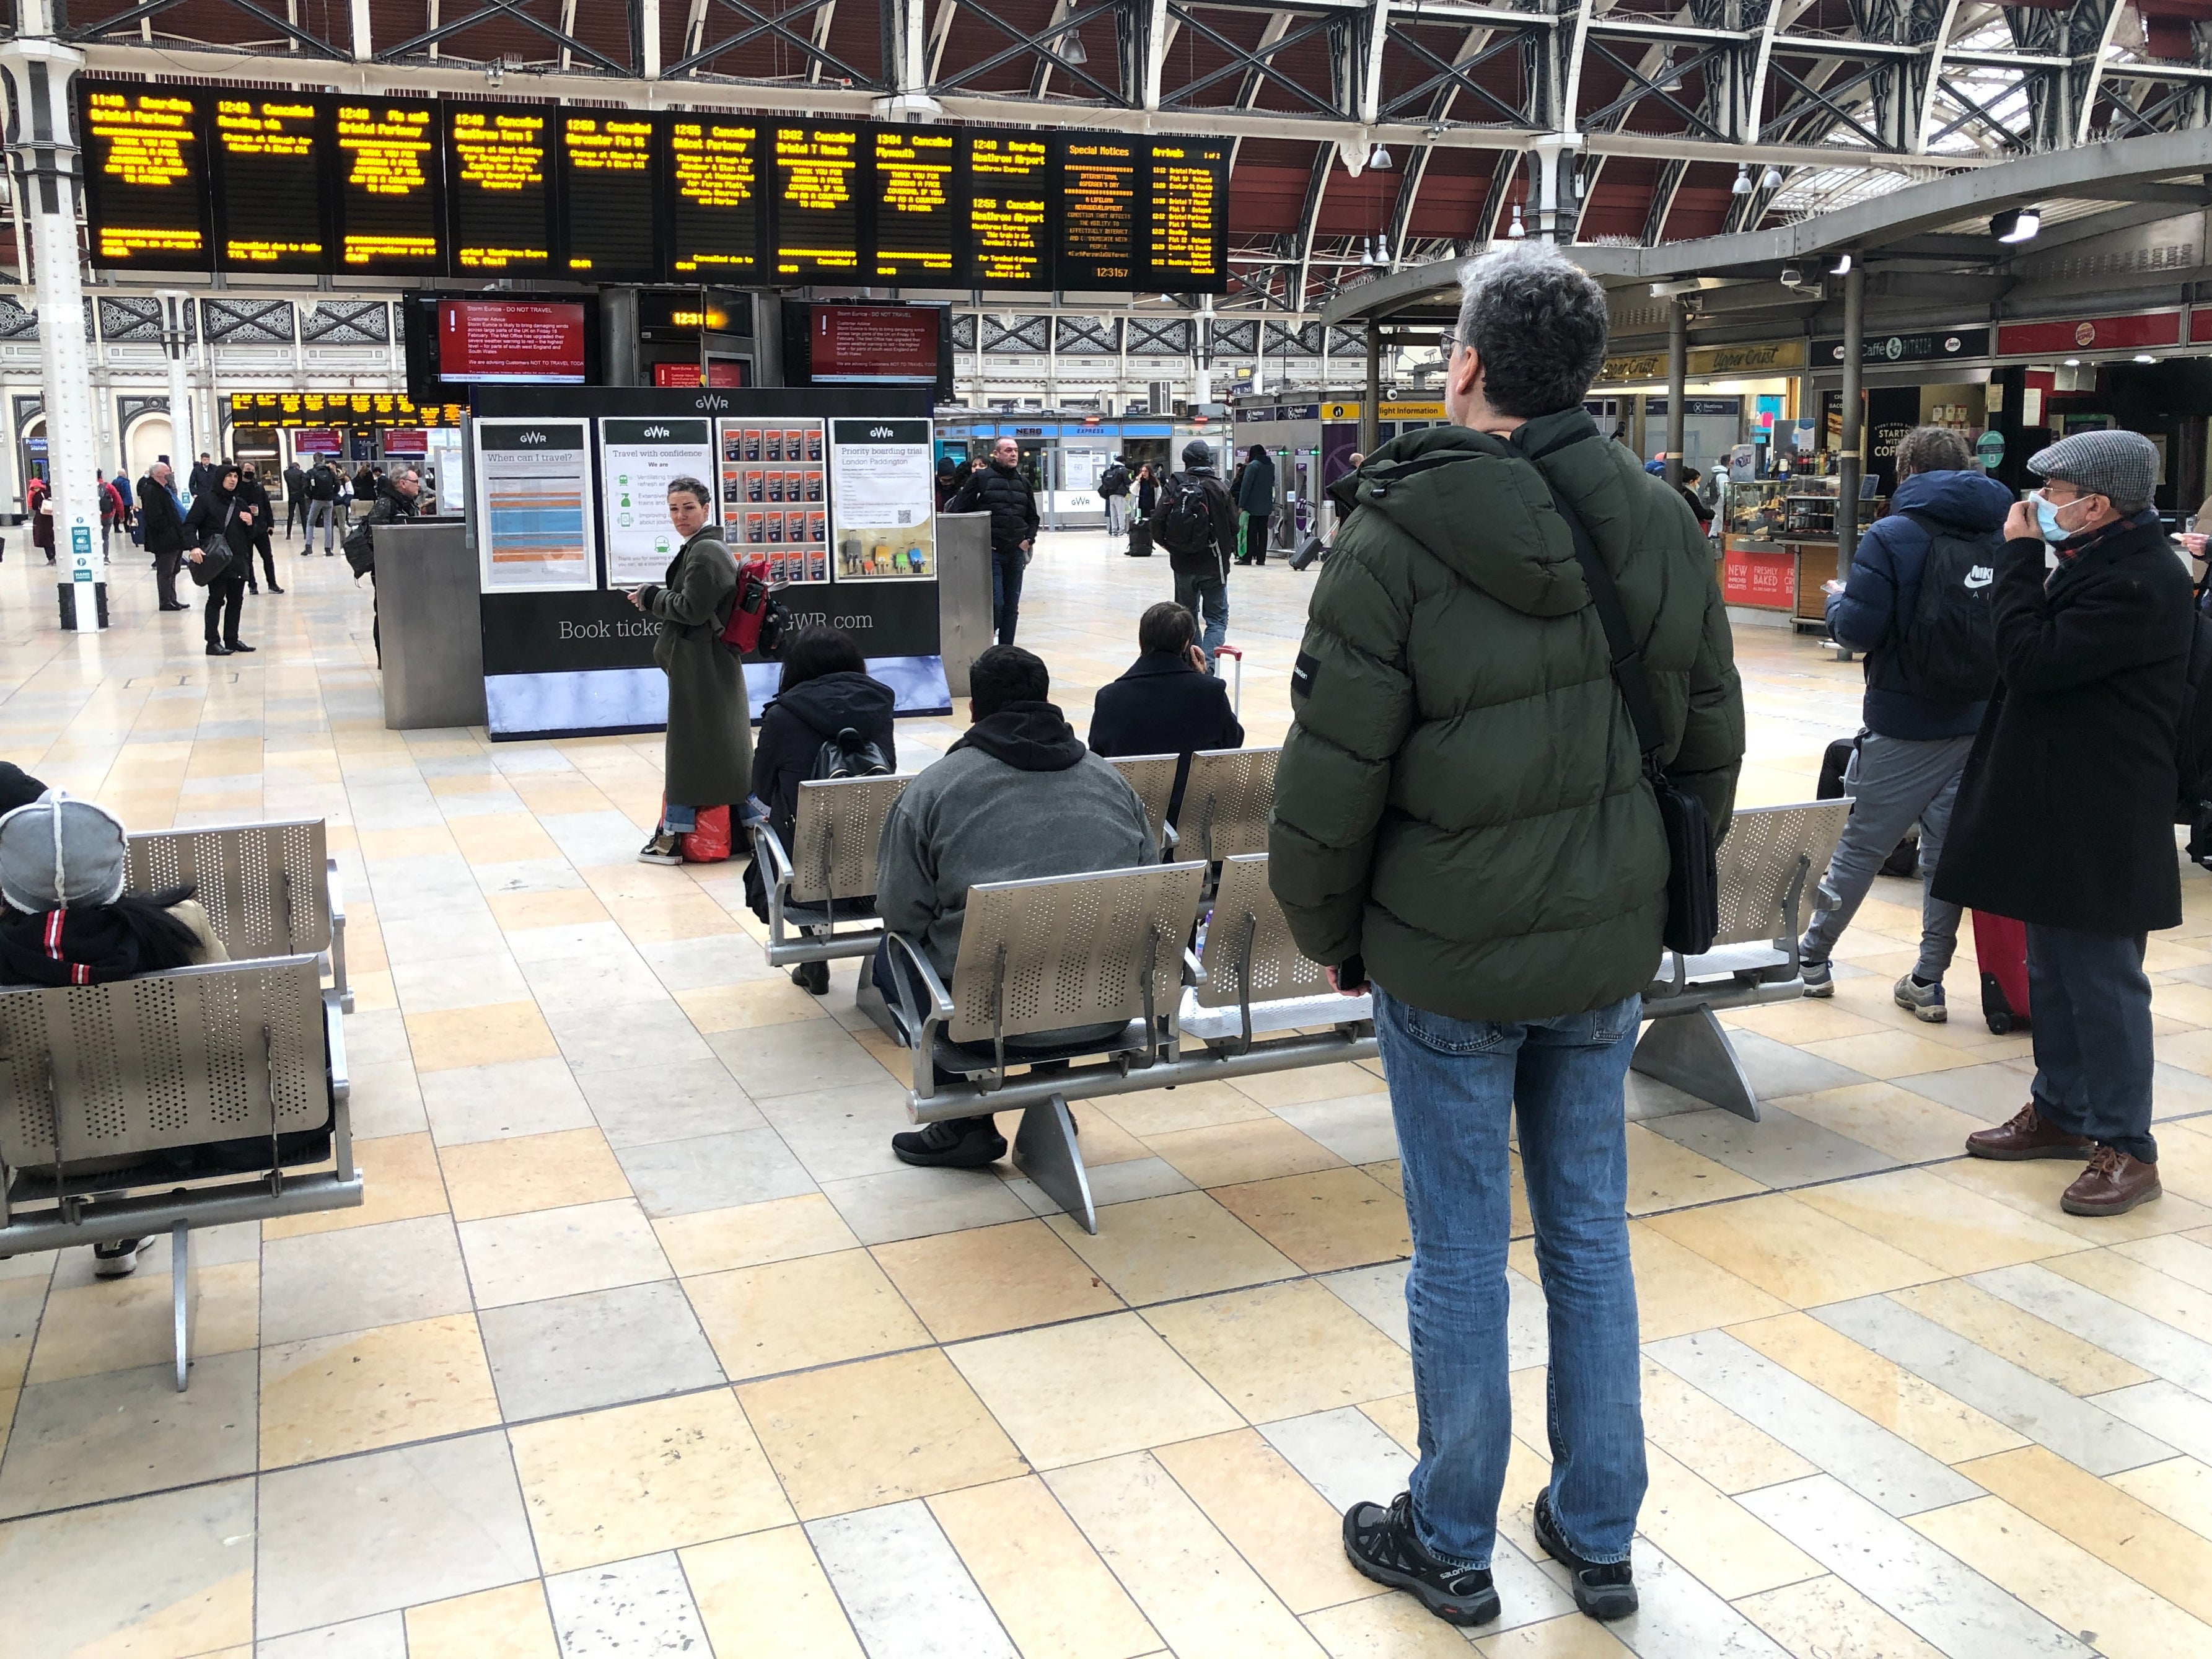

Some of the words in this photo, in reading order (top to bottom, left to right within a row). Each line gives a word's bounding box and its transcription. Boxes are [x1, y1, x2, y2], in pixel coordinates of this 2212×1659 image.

[140, 97, 191, 112] Boarding
[263, 103, 314, 117] Cancelled
[91, 109, 131, 122] Bristol
[218, 115, 261, 130] Reading
[339, 122, 375, 134] Bristol
[496, 116, 543, 128] Cancelled
[607, 121, 651, 134] Cancelled
[455, 128, 498, 139] Heathrow
[501, 130, 523, 141] Term
[525, 131, 532, 141] 5
[675, 125, 701, 136] 12:55
[713, 126, 755, 138] Cancelled
[778, 130, 803, 140] 13:02
[815, 131, 855, 143] Cancelled
[566, 133, 613, 145] Worcester
[674, 138, 703, 149] Didcot
[706, 139, 746, 152] Parkway
[877, 134, 901, 144] 13:04
[913, 136, 952, 147] Cancelled
[777, 143, 808, 154] Bristol
[811, 144, 817, 154] T
[821, 145, 848, 155] Meads
[876, 147, 915, 158] Plymouth
[974, 140, 996, 149] 12:40
[1009, 142, 1045, 153] Boarding
[1069, 145, 1097, 154] Special
[1100, 146, 1129, 156] Notices
[1153, 147, 1183, 157] Arrivals
[973, 152, 1012, 163] Heathrow
[1015, 155, 1045, 165] Airport
[973, 199, 996, 208] 12:55
[1006, 200, 1043, 210] Cancelled
[972, 211, 1011, 221] Heathrow
[1014, 213, 1043, 223] Airport
[1863, 343, 1885, 357] Caffè
[1902, 338, 1932, 354] RITAZZA
[1628, 357, 1658, 373] Crust
[1712, 351, 1746, 372] Upper
[1745, 347, 1779, 364] Crust
[695, 394, 729, 410] GWR
[1379, 407, 1395, 417] light
[520, 430, 546, 444] GWR
[644, 425, 670, 439] GWR
[870, 426, 893, 438] GWR
[1879, 429, 1910, 438] STARTS
[660, 449, 703, 457] confidence
[841, 447, 869, 455] Priority
[872, 447, 905, 455] boarding
[1874, 446, 1896, 457] COF
[488, 454, 514, 462] When
[542, 453, 573, 462] travel?
[870, 458, 908, 467] Paddington
[1071, 496, 1090, 506] GWR
[1728, 564, 1748, 576] NEW
[1753, 566, 1778, 575] FRESHLY
[1753, 574, 1778, 586] BAKED
[1786, 586, 1794, 594] BR
[1973, 591, 1990, 600] AI
[559, 620, 611, 639] Book
[616, 618, 663, 637] ticke
